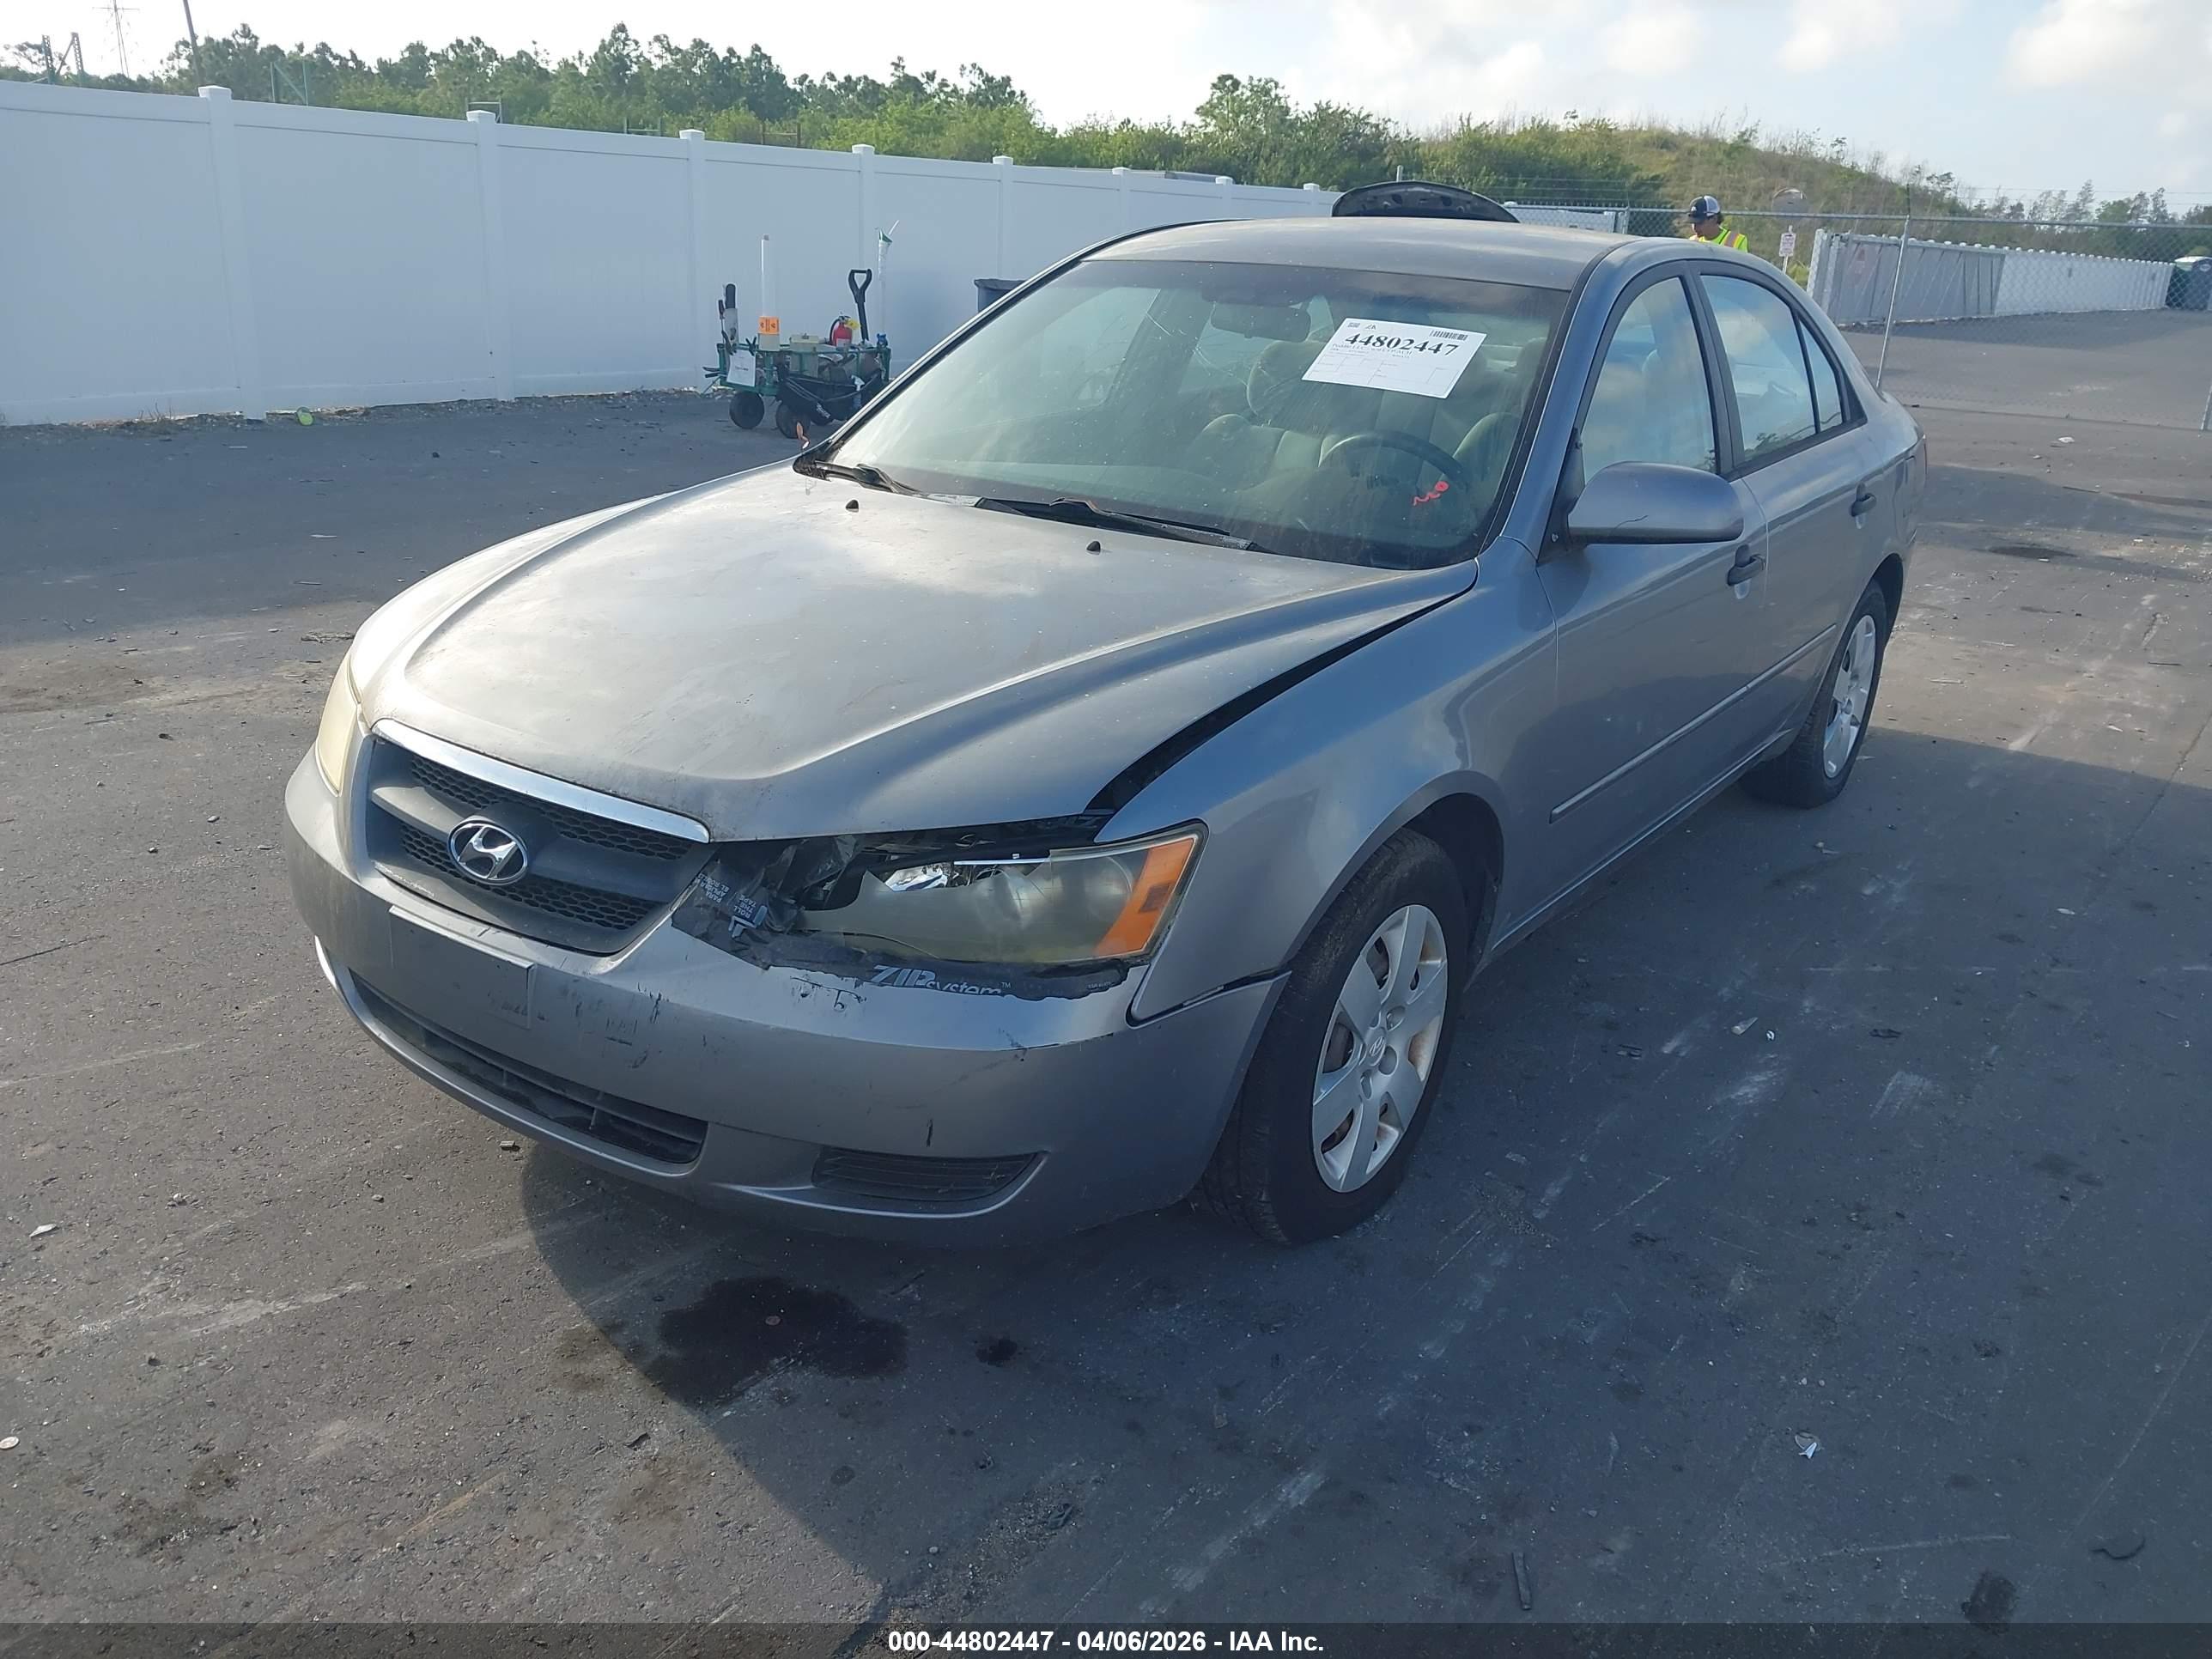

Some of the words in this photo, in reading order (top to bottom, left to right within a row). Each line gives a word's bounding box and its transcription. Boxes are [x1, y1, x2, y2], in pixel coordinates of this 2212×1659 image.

[1344, 332, 1460, 356] 44802447
[738, 894, 757, 908] TAPE
[739, 902, 753, 914] THE
[733, 905, 751, 919] ROLL
[871, 964, 936, 987] ZIP
